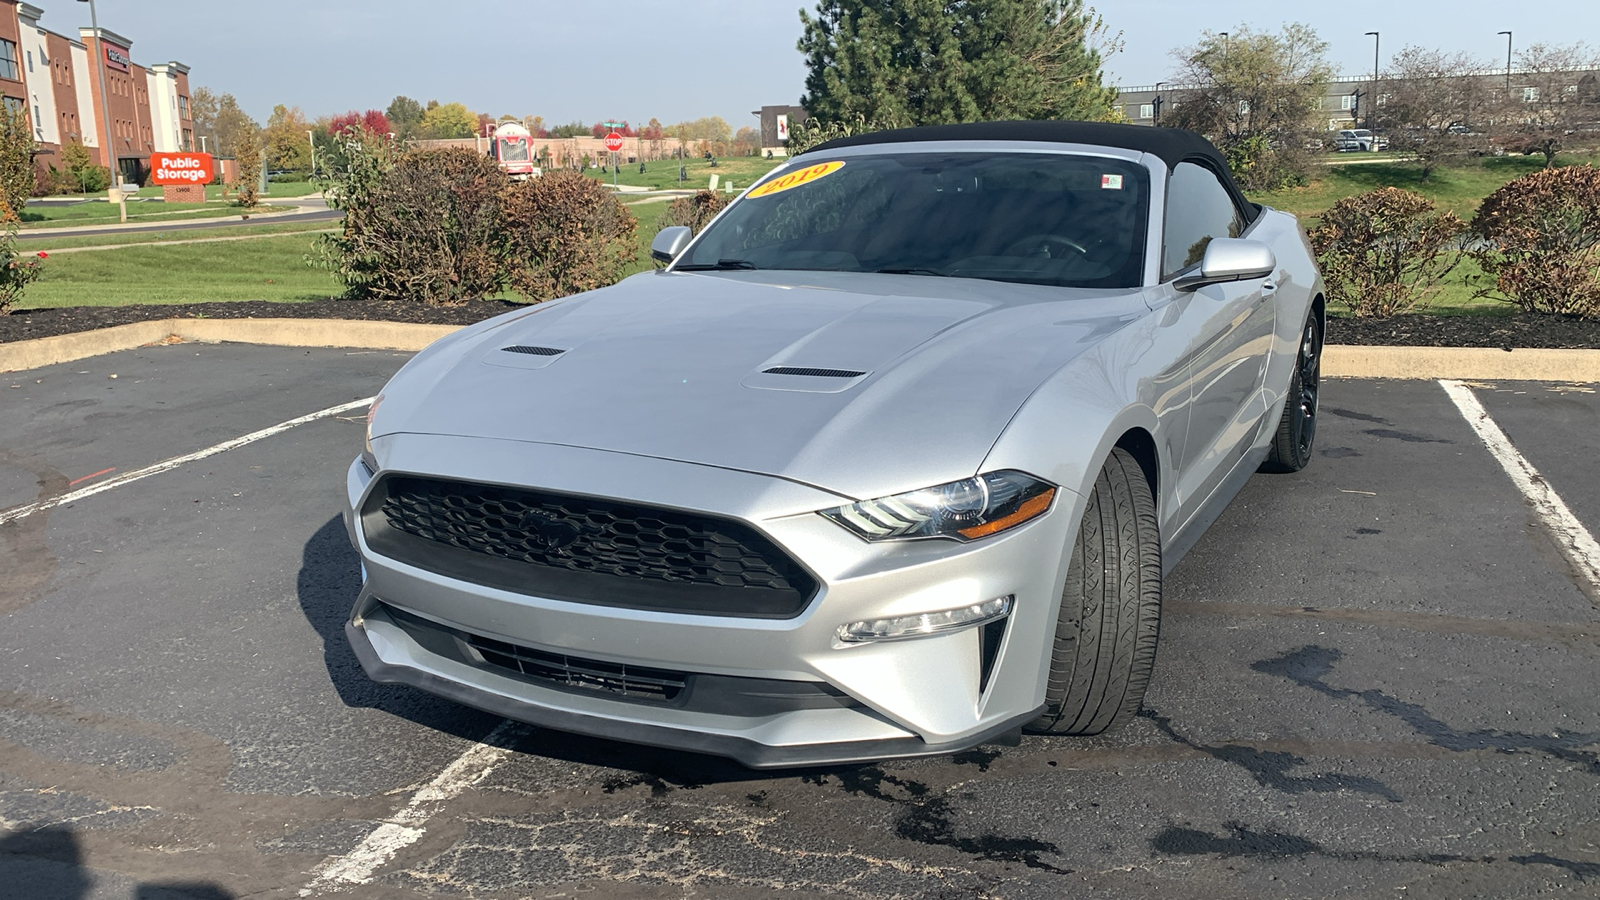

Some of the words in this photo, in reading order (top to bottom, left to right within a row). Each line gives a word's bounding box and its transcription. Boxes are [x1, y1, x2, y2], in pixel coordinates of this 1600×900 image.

[605, 138, 622, 146] STOP
[161, 157, 200, 169] Public
[157, 168, 205, 181] Storage
[761, 164, 829, 195] 2019
